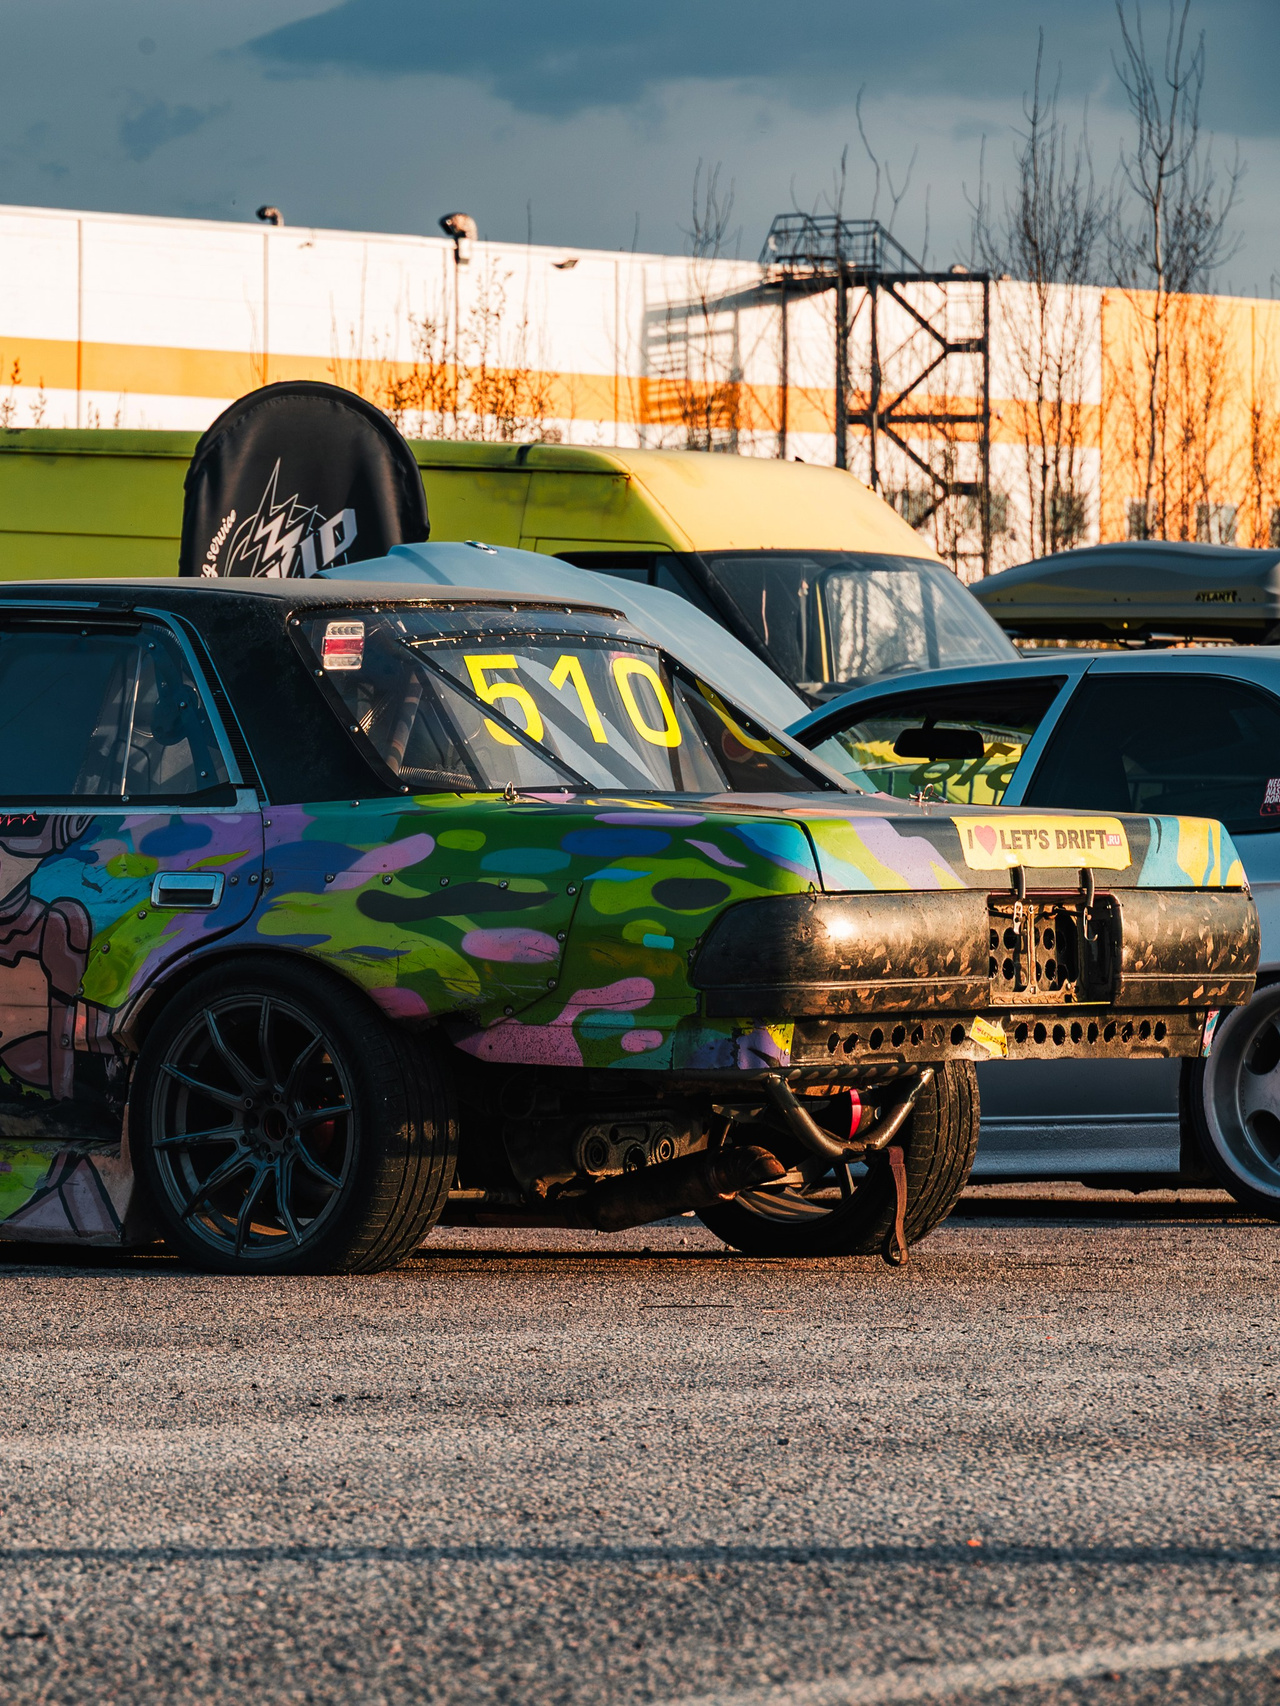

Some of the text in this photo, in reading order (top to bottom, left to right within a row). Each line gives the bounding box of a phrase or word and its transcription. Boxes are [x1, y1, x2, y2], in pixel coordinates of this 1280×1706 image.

[206, 509, 237, 562] service
[463, 654, 682, 748] 510
[967, 829, 974, 850] I
[999, 829, 1050, 850] LET'S
